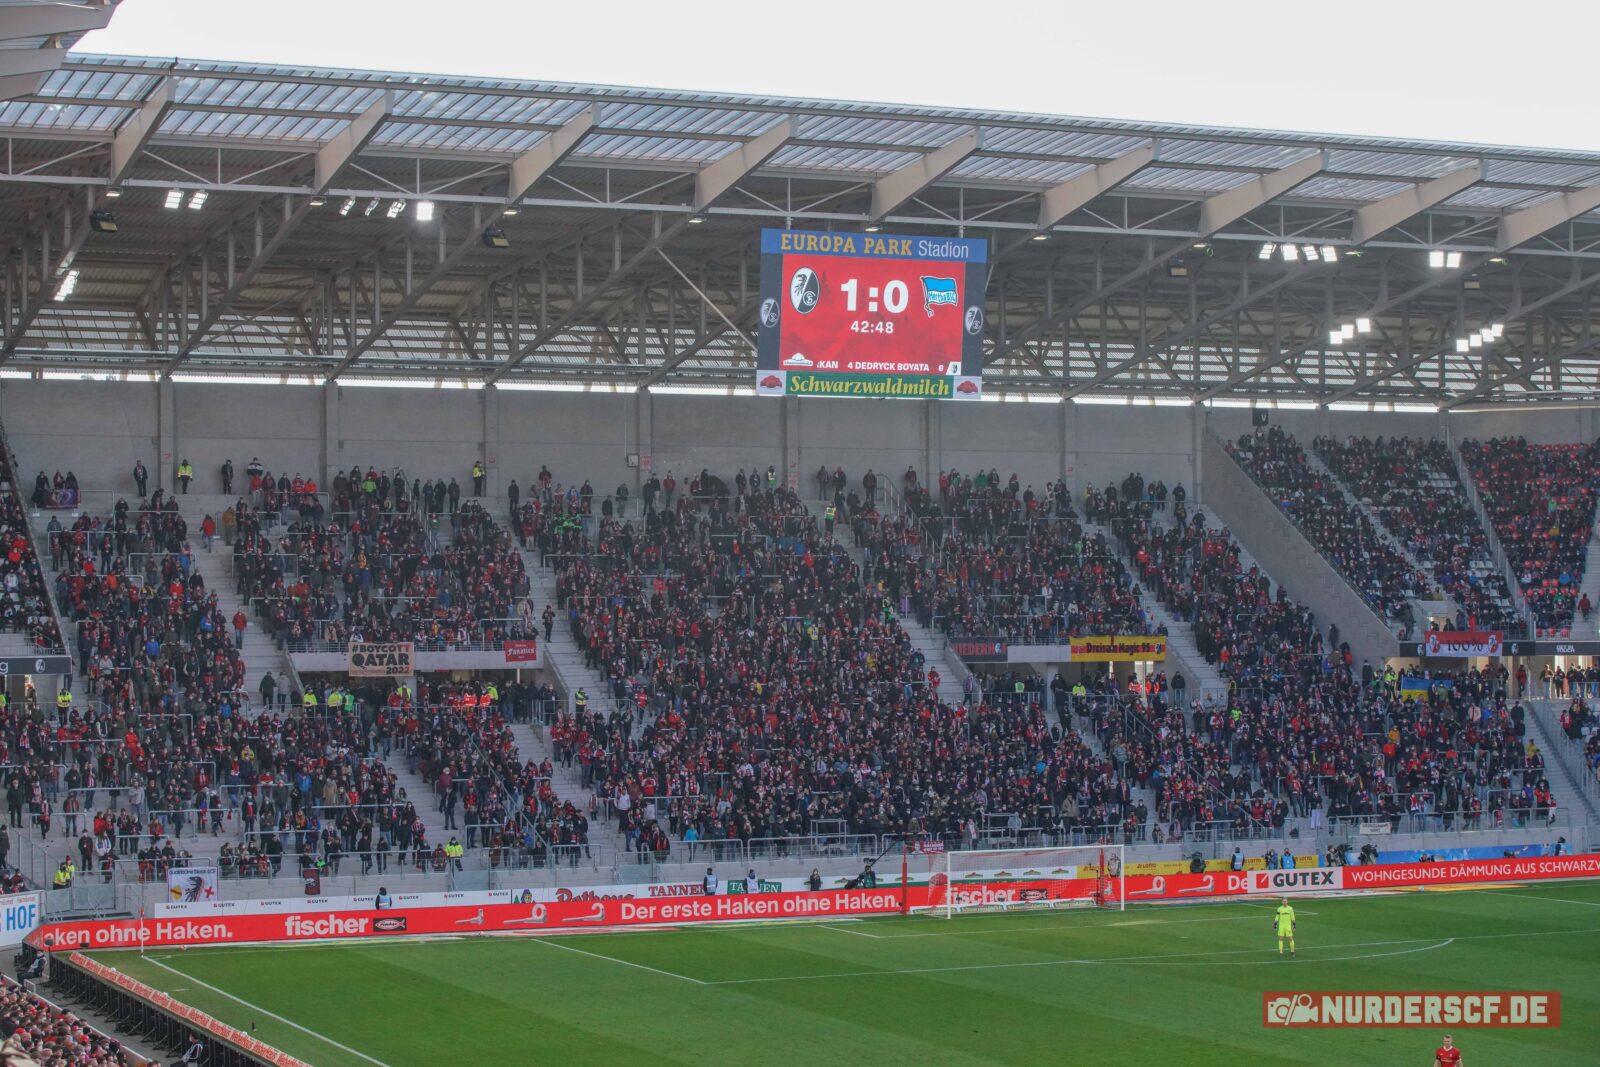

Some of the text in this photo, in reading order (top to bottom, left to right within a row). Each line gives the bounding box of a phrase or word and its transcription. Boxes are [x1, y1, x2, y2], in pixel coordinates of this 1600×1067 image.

[781, 233, 969, 258] EUROPA PARK Stadion
[840, 278, 909, 313] 1:0
[850, 321, 894, 334] 42:48
[855, 362, 896, 371] DEDRYCK
[897, 363, 930, 372] BOYATA
[790, 375, 950, 396] Schwarzwaldmilch
[352, 644, 411, 653] #BOYCOTT
[352, 653, 410, 667] QATAR
[386, 666, 411, 675] 2022
[1273, 871, 1334, 888] GUTEX
[1352, 868, 1447, 883] WOHNGESUNDE
[1450, 863, 1511, 878] DÄMMUNG
[1514, 863, 1537, 874] AUS
[621, 903, 659, 920] Der
[661, 900, 712, 918] erste
[718, 897, 779, 916] Haken
[781, 895, 831, 913] ohne
[835, 893, 900, 911] Haken.
[6, 904, 36, 931] HOF
[285, 914, 368, 936] fischer
[96, 924, 150, 943] ohne
[156, 921, 233, 940] Haken.
